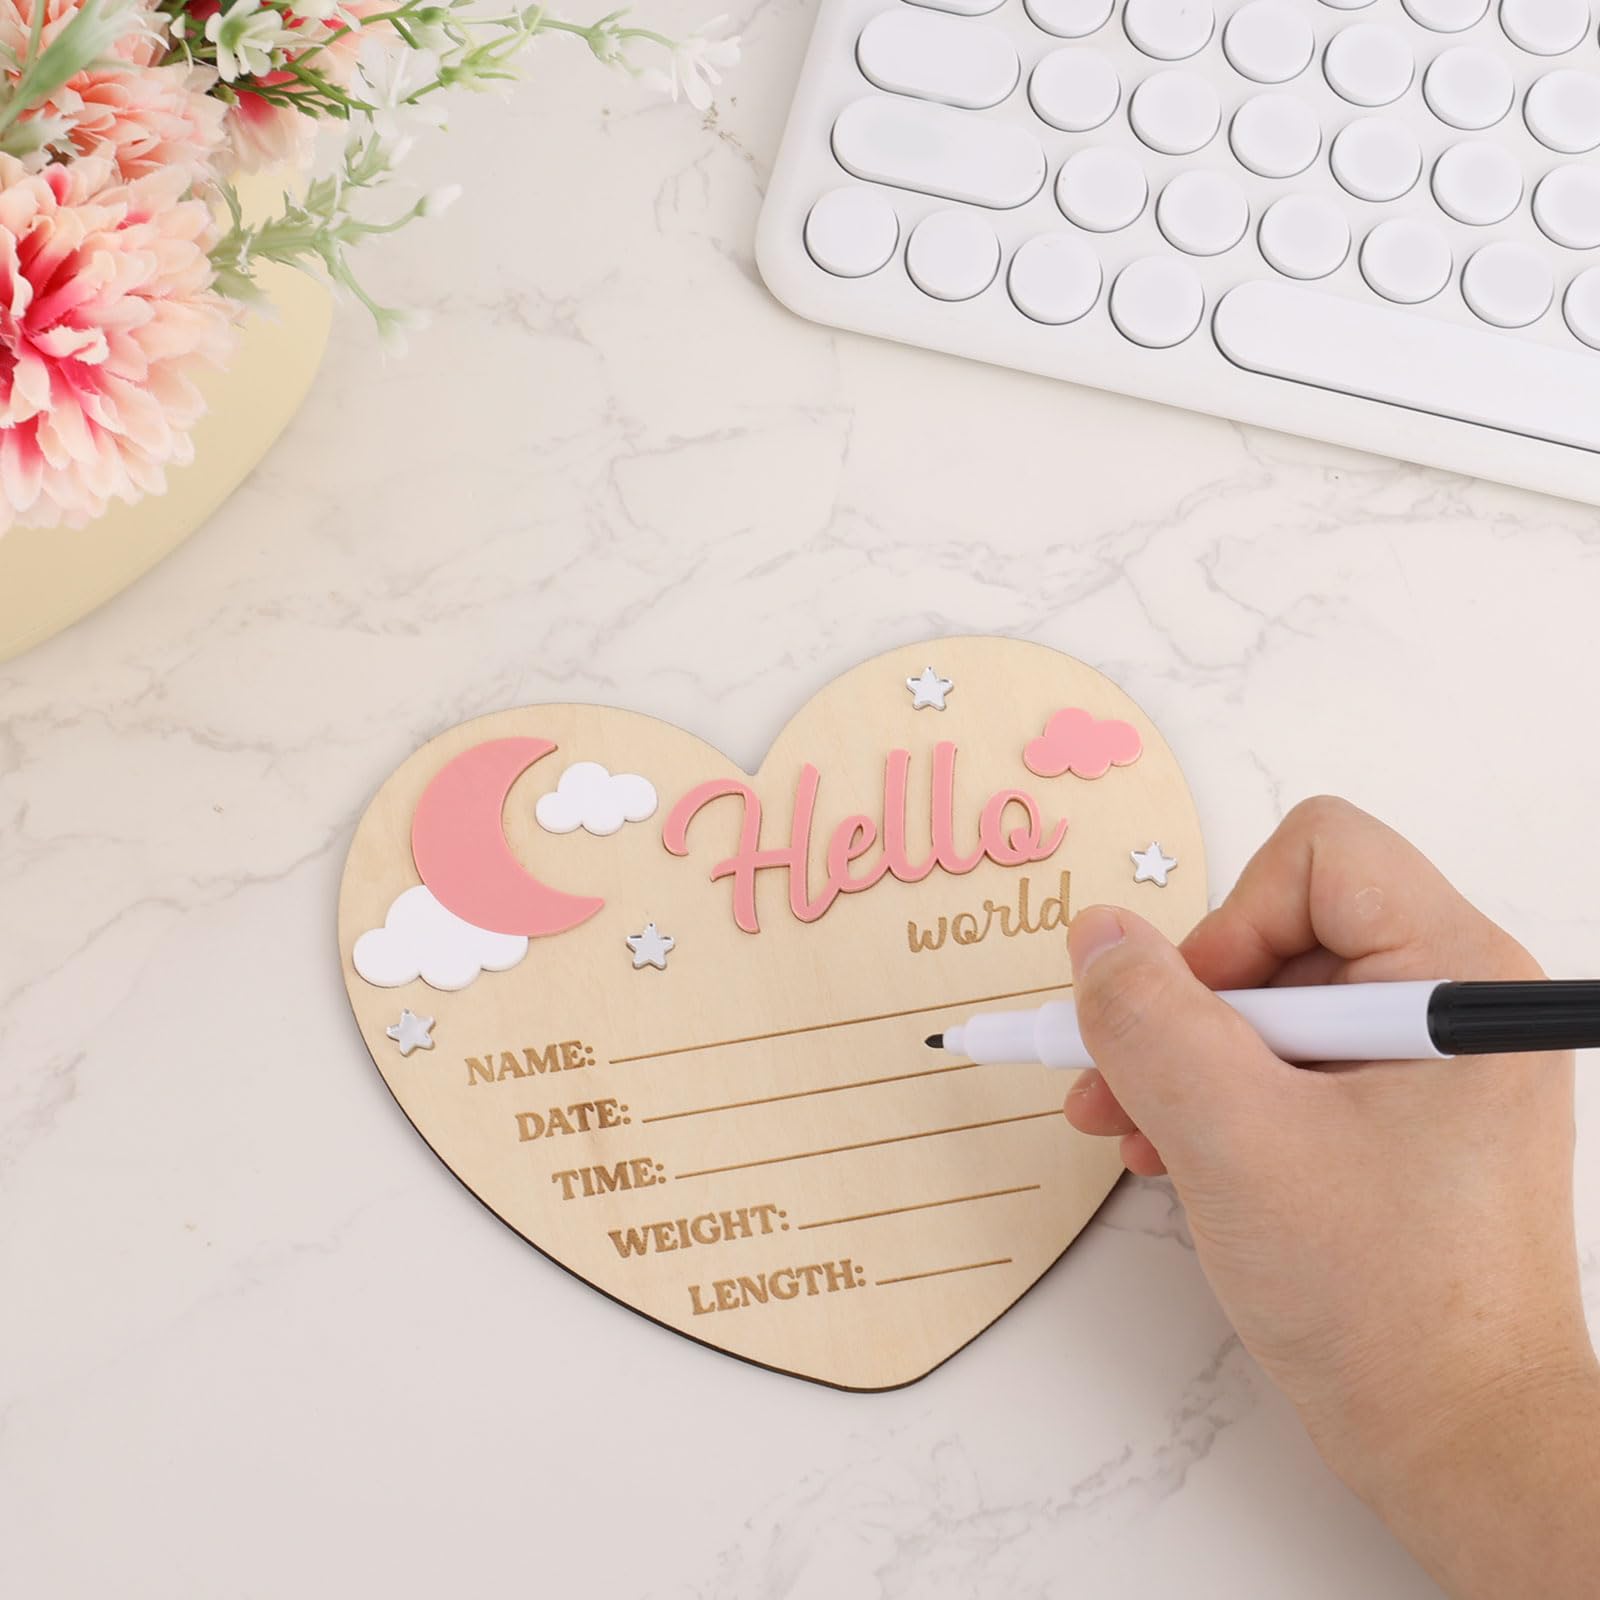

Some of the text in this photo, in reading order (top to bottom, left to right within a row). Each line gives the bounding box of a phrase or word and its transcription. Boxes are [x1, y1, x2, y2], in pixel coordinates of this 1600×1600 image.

[662, 740, 1068, 934] Hello
[908, 871, 1074, 953] world
[464, 1040, 595, 1086] NAME:
[514, 1098, 631, 1142] DATE:
[551, 1157, 666, 1201] TIME:
[608, 1203, 790, 1259] WEIGHT:
[687, 1258, 866, 1316] LENGTH:
